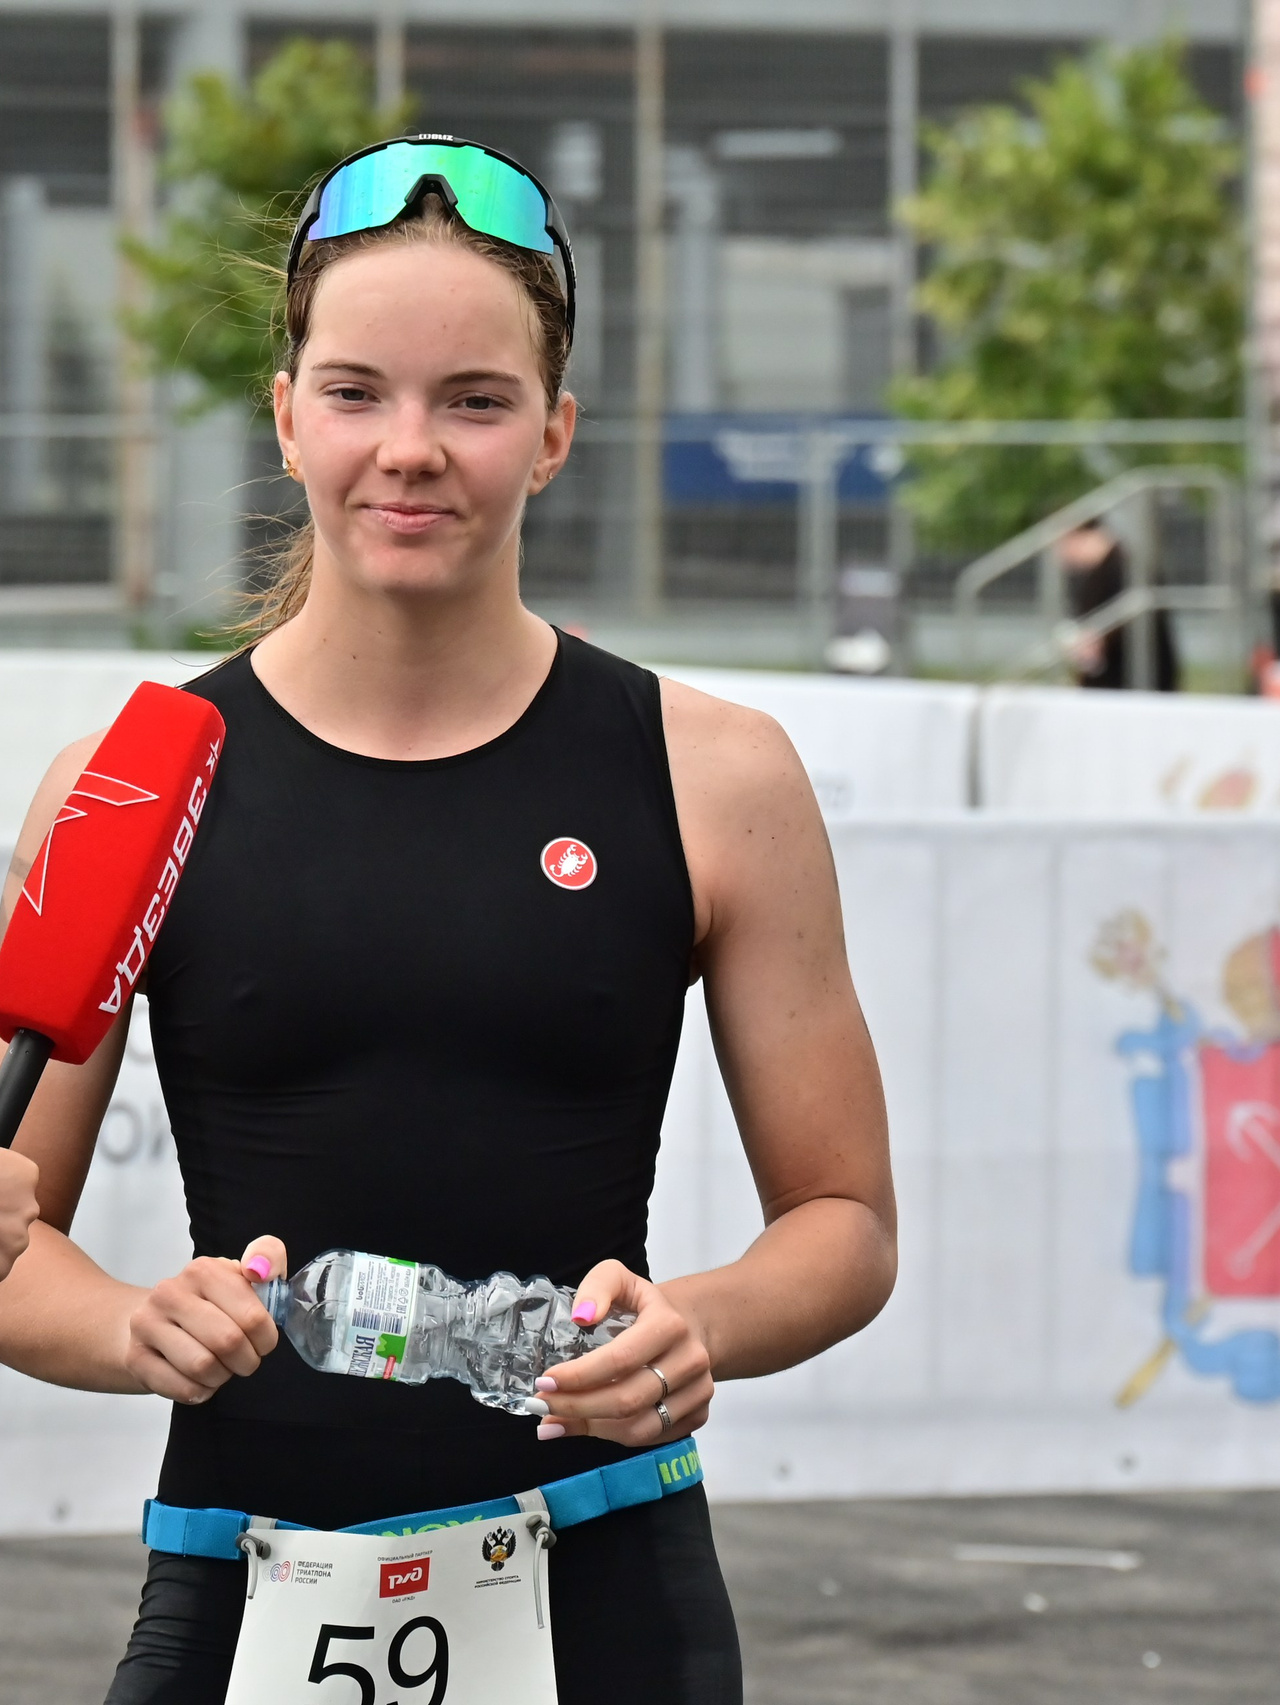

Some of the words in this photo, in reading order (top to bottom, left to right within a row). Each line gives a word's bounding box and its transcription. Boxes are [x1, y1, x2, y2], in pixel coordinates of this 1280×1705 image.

[98, 776, 208, 1015] ЗВЕЗДА
[297, 1560, 333, 1570] ФЕДЕРАЦИЯ
[296, 1568, 332, 1578] ТРИАТЛОНА
[294, 1576, 318, 1585] РОССИИ
[308, 1616, 449, 1705] 59
